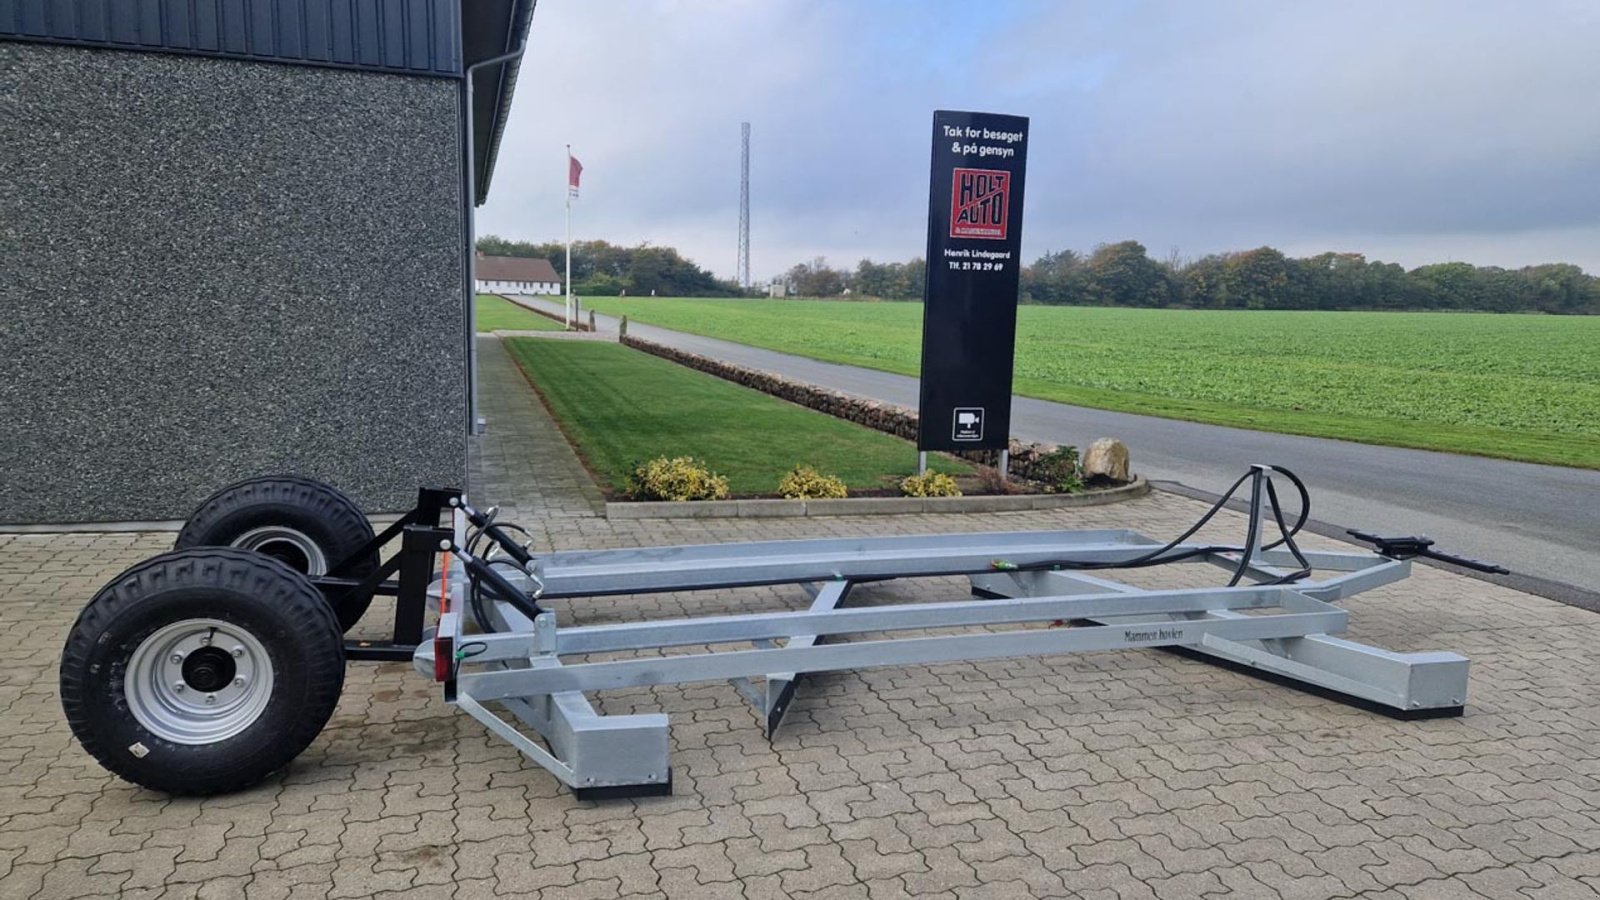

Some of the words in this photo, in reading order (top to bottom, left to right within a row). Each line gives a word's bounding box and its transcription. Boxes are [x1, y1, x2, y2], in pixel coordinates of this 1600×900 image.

[943, 125, 962, 137] Tak
[965, 126, 981, 138] for
[983, 127, 1023, 143] besøget
[952, 141, 961, 153] &
[963, 142, 978, 156] på
[979, 145, 1014, 159] gensyn
[960, 173, 1004, 207] HOLT
[957, 190, 1003, 225] AUTO
[944, 248, 970, 258] Henrik
[962, 262, 971, 270] 21
[983, 262, 993, 271] 29
